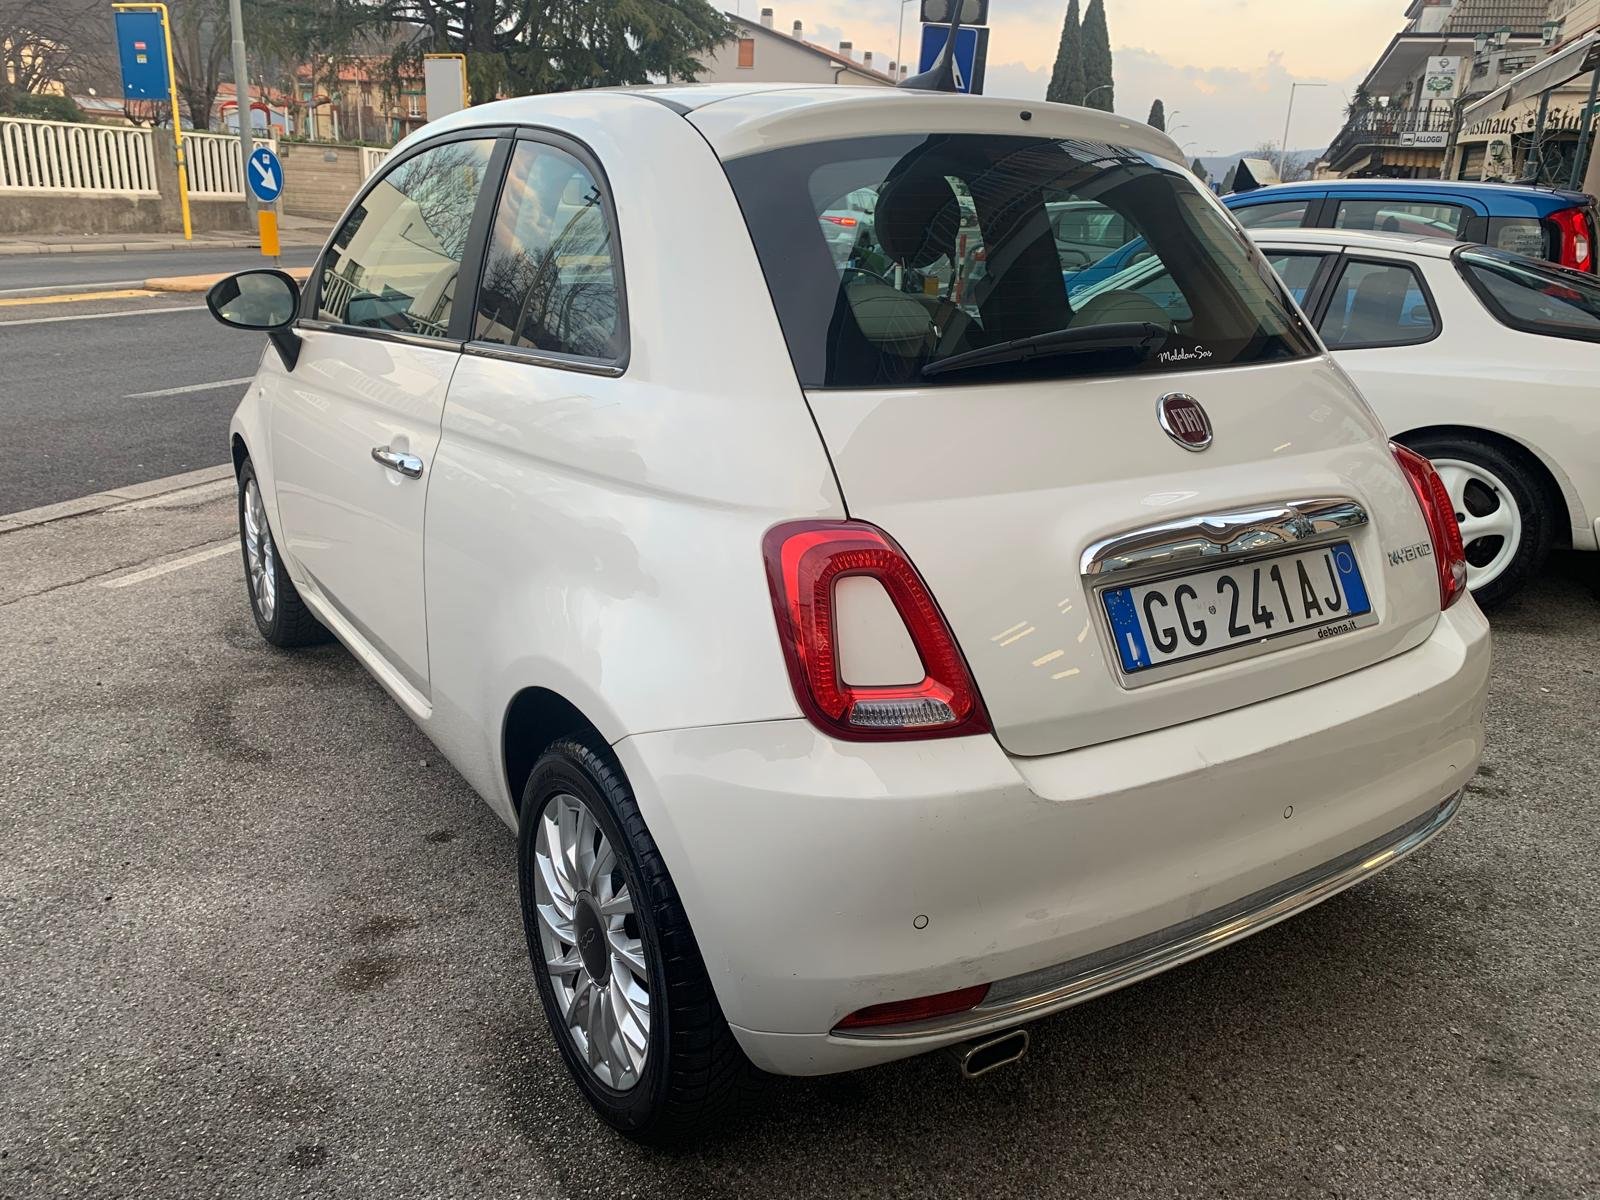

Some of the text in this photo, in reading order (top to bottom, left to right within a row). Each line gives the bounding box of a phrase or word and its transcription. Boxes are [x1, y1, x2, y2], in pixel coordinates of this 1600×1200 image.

[1464, 116, 1519, 136] asthaus
[1415, 135, 1443, 143] ALLOGGI
[1170, 406, 1204, 434] FIAT
[1387, 543, 1431, 567] HYBRID
[1142, 553, 1342, 654] GG 241AJ
[1317, 619, 1357, 639] debona.it
